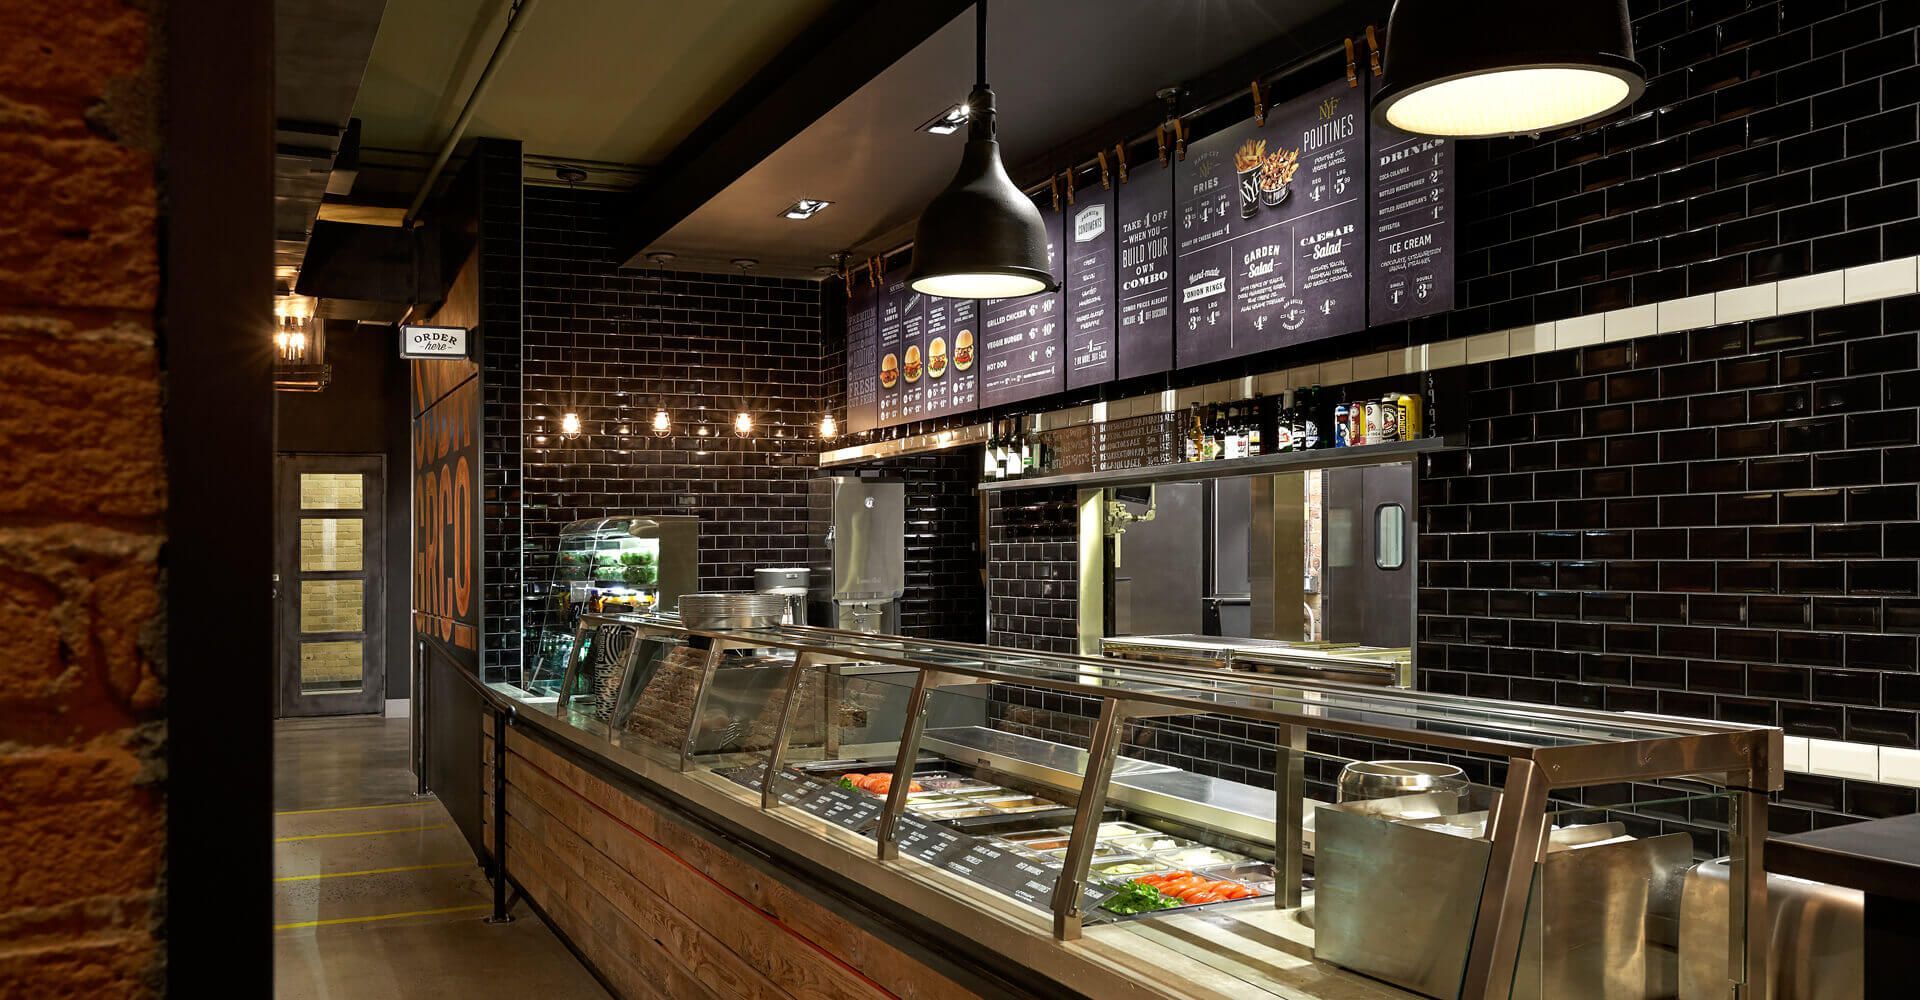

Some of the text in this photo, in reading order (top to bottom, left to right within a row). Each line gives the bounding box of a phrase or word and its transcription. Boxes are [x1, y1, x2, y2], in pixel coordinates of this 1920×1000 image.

[1320, 98, 1340, 120] NYF
[1304, 114, 1354, 152] POUTINES
[1194, 177, 1218, 194] FRIES
[1379, 188, 1395, 198] BOTTLED
[1379, 206, 1395, 215] BOTTLED
[1078, 217, 1102, 235] CONDIMENTS
[1123, 220, 1142, 232] TAKE
[1152, 210, 1168, 223] OFF
[1129, 226, 1160, 243] WHEN YOU
[1300, 224, 1354, 246] CAESAR
[1123, 236, 1168, 268] BUILD YOUR
[1313, 239, 1342, 260] Salad
[1390, 234, 1432, 254] ICE CREAM
[1244, 244, 1280, 264] GARDEN
[1136, 262, 1154, 275] OWN
[1248, 258, 1274, 278] Salad
[1123, 270, 1168, 290] COMBO
[1187, 282, 1222, 298] ONION RINGS
[1137, 300, 1150, 309] PRICES
[1151, 296, 1168, 306] ALREADY
[987, 316, 1006, 328] GRILLED
[1006, 309, 1027, 322] CHICKEN
[414, 333, 457, 345] ORDER
[425, 341, 447, 350] here
[987, 339, 1003, 350] VEGGIE
[1004, 333, 1023, 344] BURGER
[987, 363, 997, 371] HOT
[997, 360, 1007, 369] DOG
[849, 376, 876, 398] FRESH
